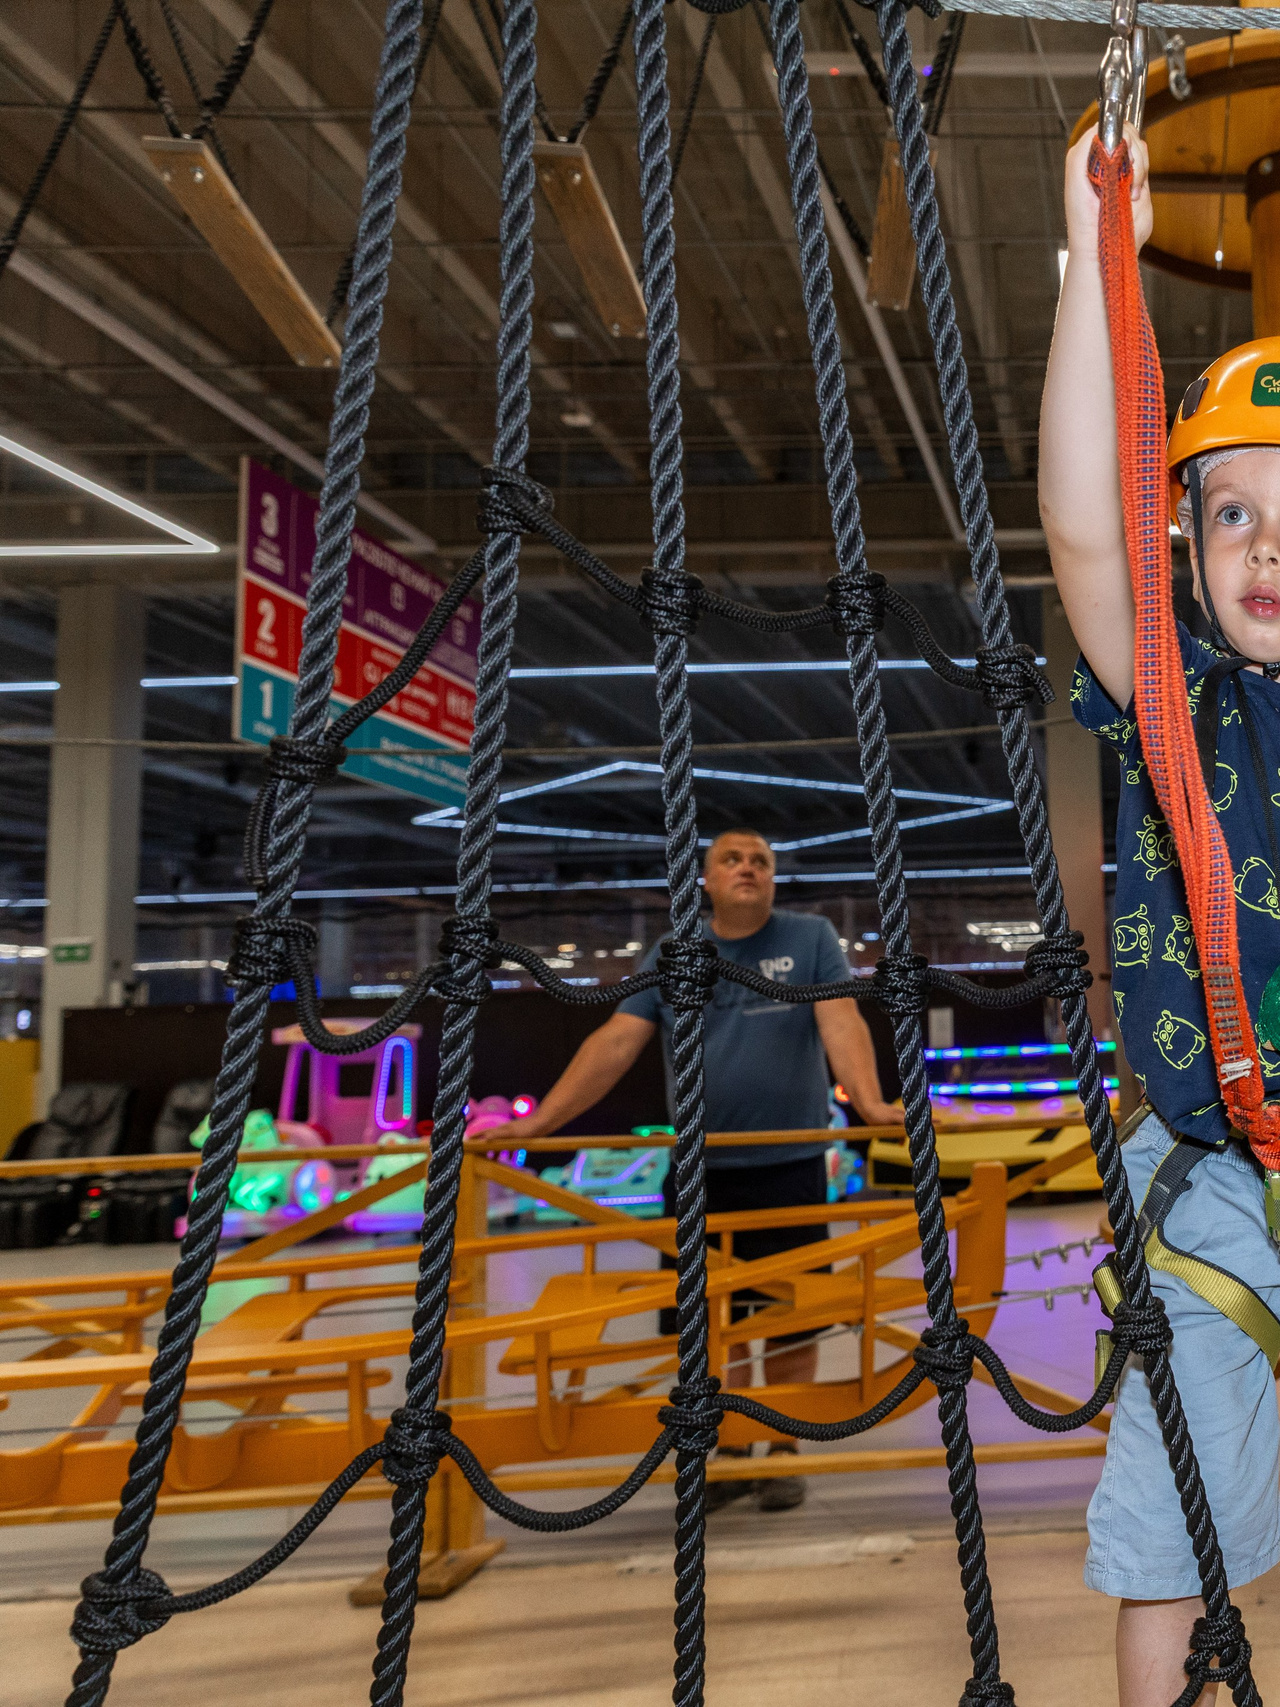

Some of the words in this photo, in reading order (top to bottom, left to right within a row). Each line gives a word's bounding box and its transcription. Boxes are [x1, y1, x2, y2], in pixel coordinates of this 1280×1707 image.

[261, 491, 280, 539] 3
[257, 597, 277, 644] 2
[259, 680, 273, 720] 1
